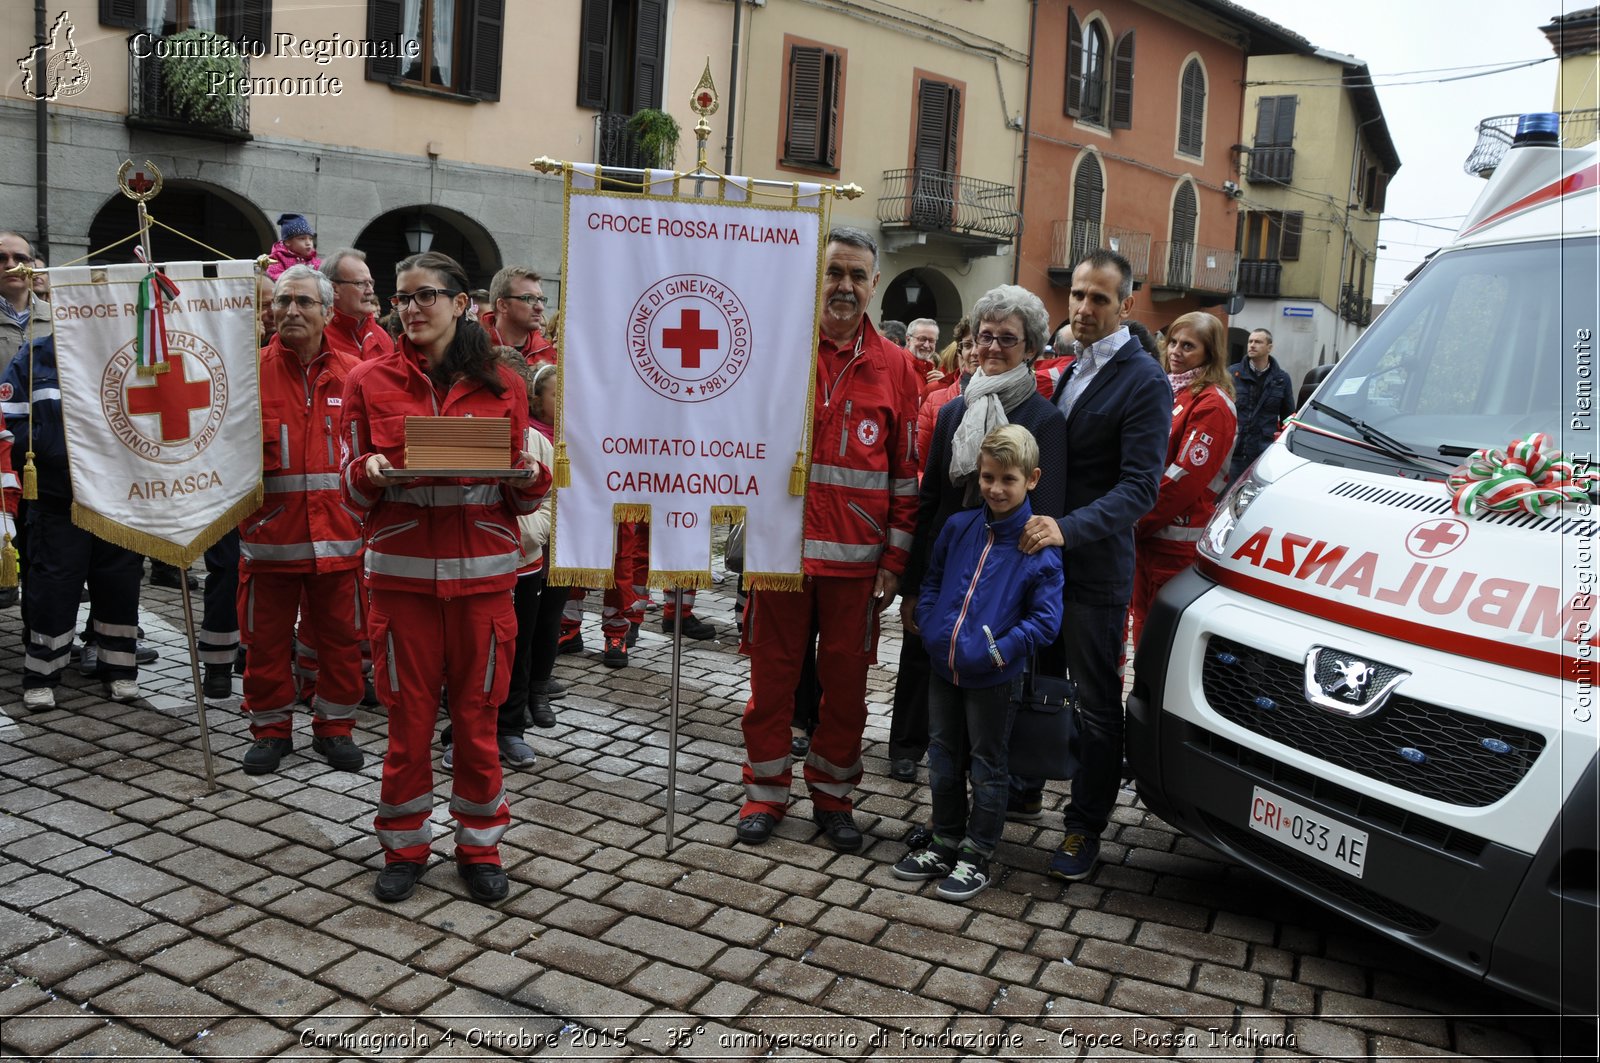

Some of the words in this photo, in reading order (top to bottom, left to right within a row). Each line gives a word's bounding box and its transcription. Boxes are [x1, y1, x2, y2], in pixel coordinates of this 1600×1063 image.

[587, 212, 652, 235] CROCE
[657, 218, 719, 240] ROSSA
[724, 223, 800, 245] ITALIANA
[648, 290, 664, 306] DI
[665, 280, 725, 303] GINEVRA
[55, 303, 118, 321] CROCE
[124, 300, 183, 316] RSA
[187, 296, 253, 313] ITALIANA
[722, 299, 739, 317] 22
[199, 345, 216, 363] 22
[632, 304, 680, 395] CONVENZIONE
[726, 318, 747, 375] AGOSTO
[114, 351, 132, 369] DI
[211, 365, 226, 421] AGOSTO
[699, 374, 727, 395] 1864
[104, 367, 160, 458] CONVENZIONE
[193, 424, 216, 451] 1864
[602, 437, 696, 457] COMITATO
[701, 440, 766, 459] LOCALE
[128, 470, 223, 500] AIRASCA
[606, 471, 759, 496] CARMAGNOLA
[666, 511, 699, 529] (TO)
[1253, 797, 1282, 831] CRI
[1292, 815, 1330, 851] 033
[1335, 834, 1364, 868] AE
